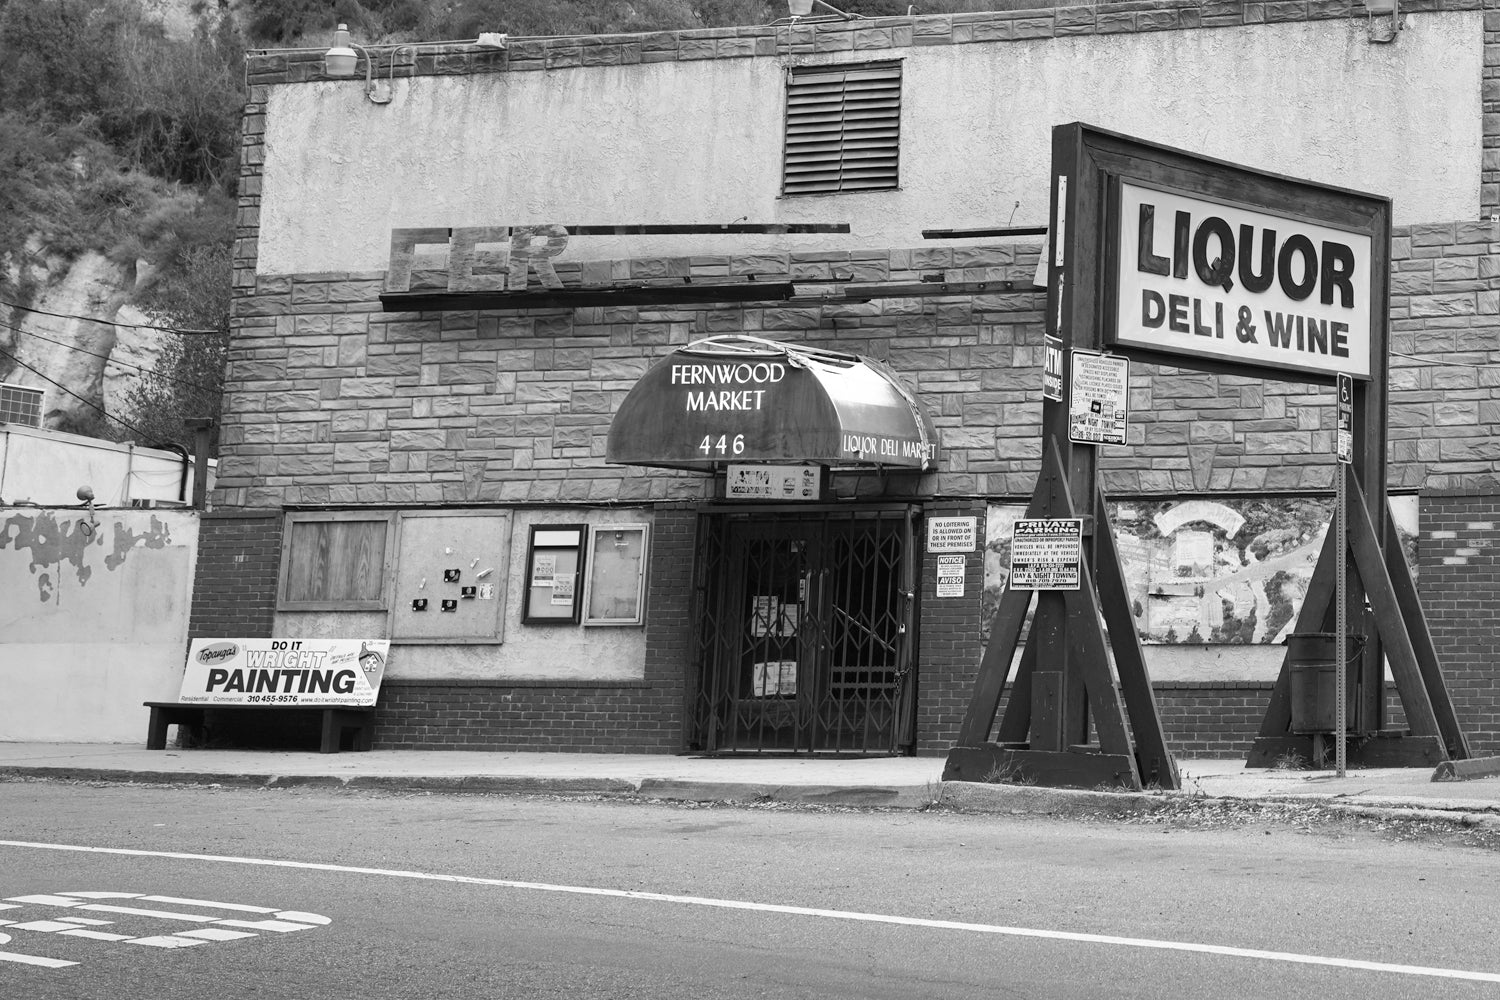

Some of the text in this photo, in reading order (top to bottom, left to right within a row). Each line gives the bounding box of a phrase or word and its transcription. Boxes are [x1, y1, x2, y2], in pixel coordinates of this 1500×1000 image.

[386, 224, 569, 293] FER
[1138, 203, 1355, 309] LIQUOR
[1142, 288, 1350, 358] DELI & WINE
[1045, 346, 1062, 376] ATM
[671, 363, 785, 385] FERNWOOD
[1044, 374, 1062, 390] INSIDE
[686, 390, 766, 411] MARKET
[699, 434, 745, 455] 446
[843, 434, 877, 454] LIQUOR
[881, 438, 899, 456] DELI
[939, 576, 962, 584] AVISO
[271, 641, 303, 650] DO IT
[205, 668, 356, 694] PAINTING
[261, 695, 298, 703] 455-9576
